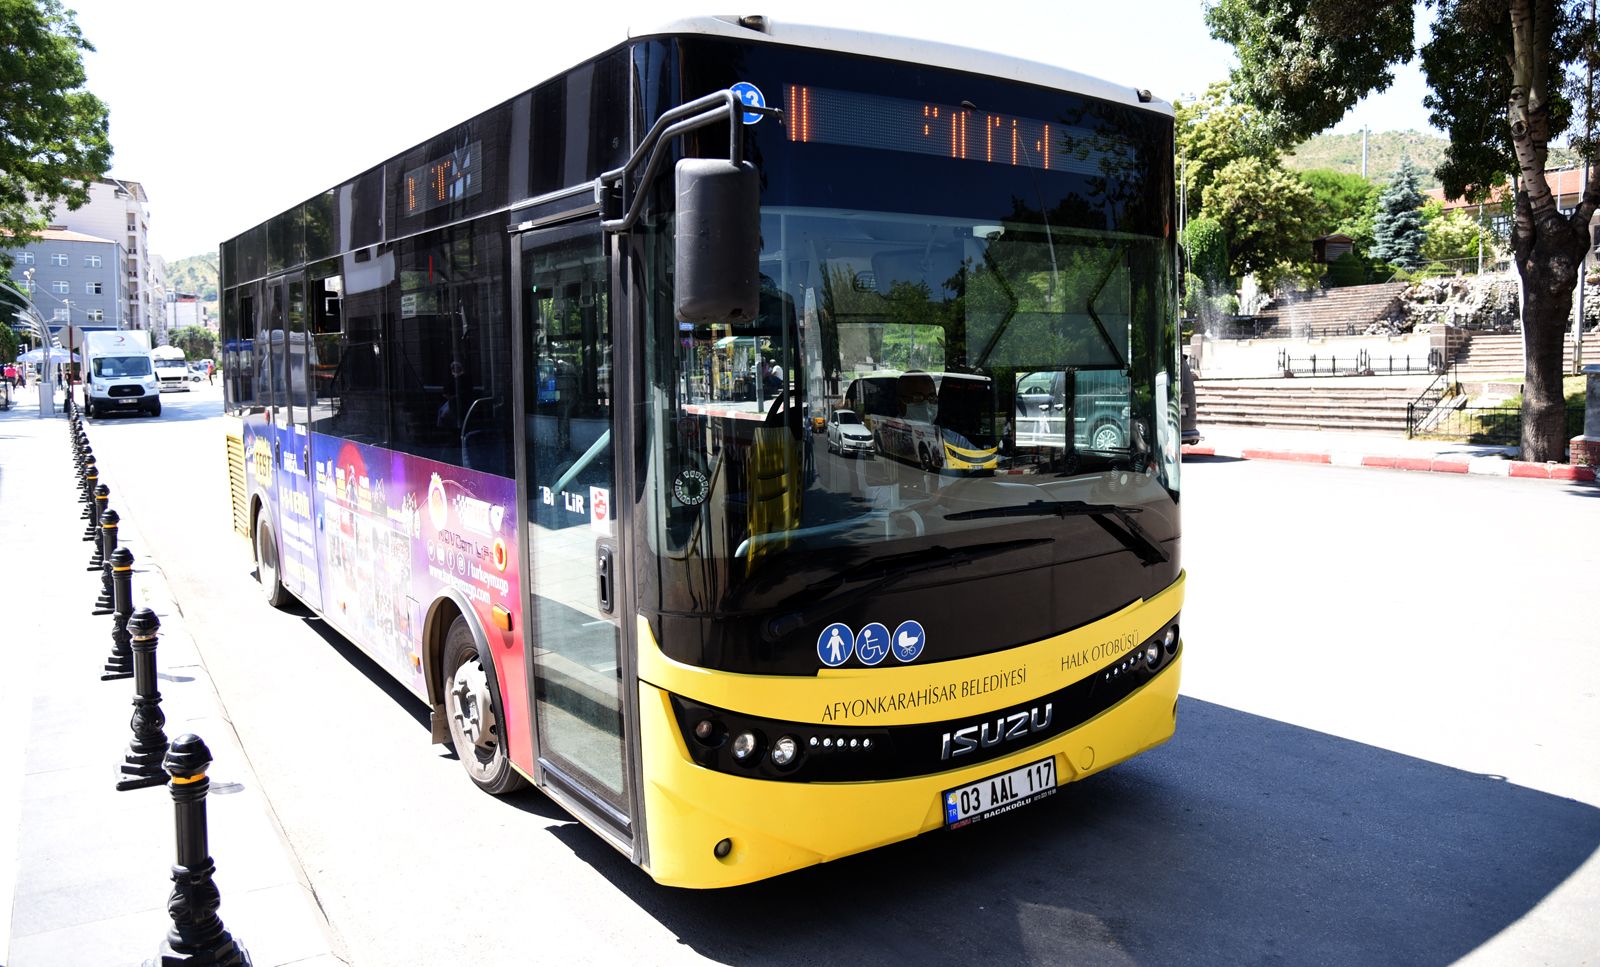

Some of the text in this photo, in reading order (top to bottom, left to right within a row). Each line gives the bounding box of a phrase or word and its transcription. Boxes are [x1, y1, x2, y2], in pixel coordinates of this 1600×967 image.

[1061, 629, 1139, 672] HALK OTOBÜSÜ
[821, 664, 1026, 722] AFYONKARAHİSAR BELEDİYESİ
[941, 703, 1053, 760] ISUZU
[948, 808, 957, 817] TR
[961, 787, 981, 815] 03
[990, 776, 1019, 806] AAL
[1027, 761, 1052, 792] 117
